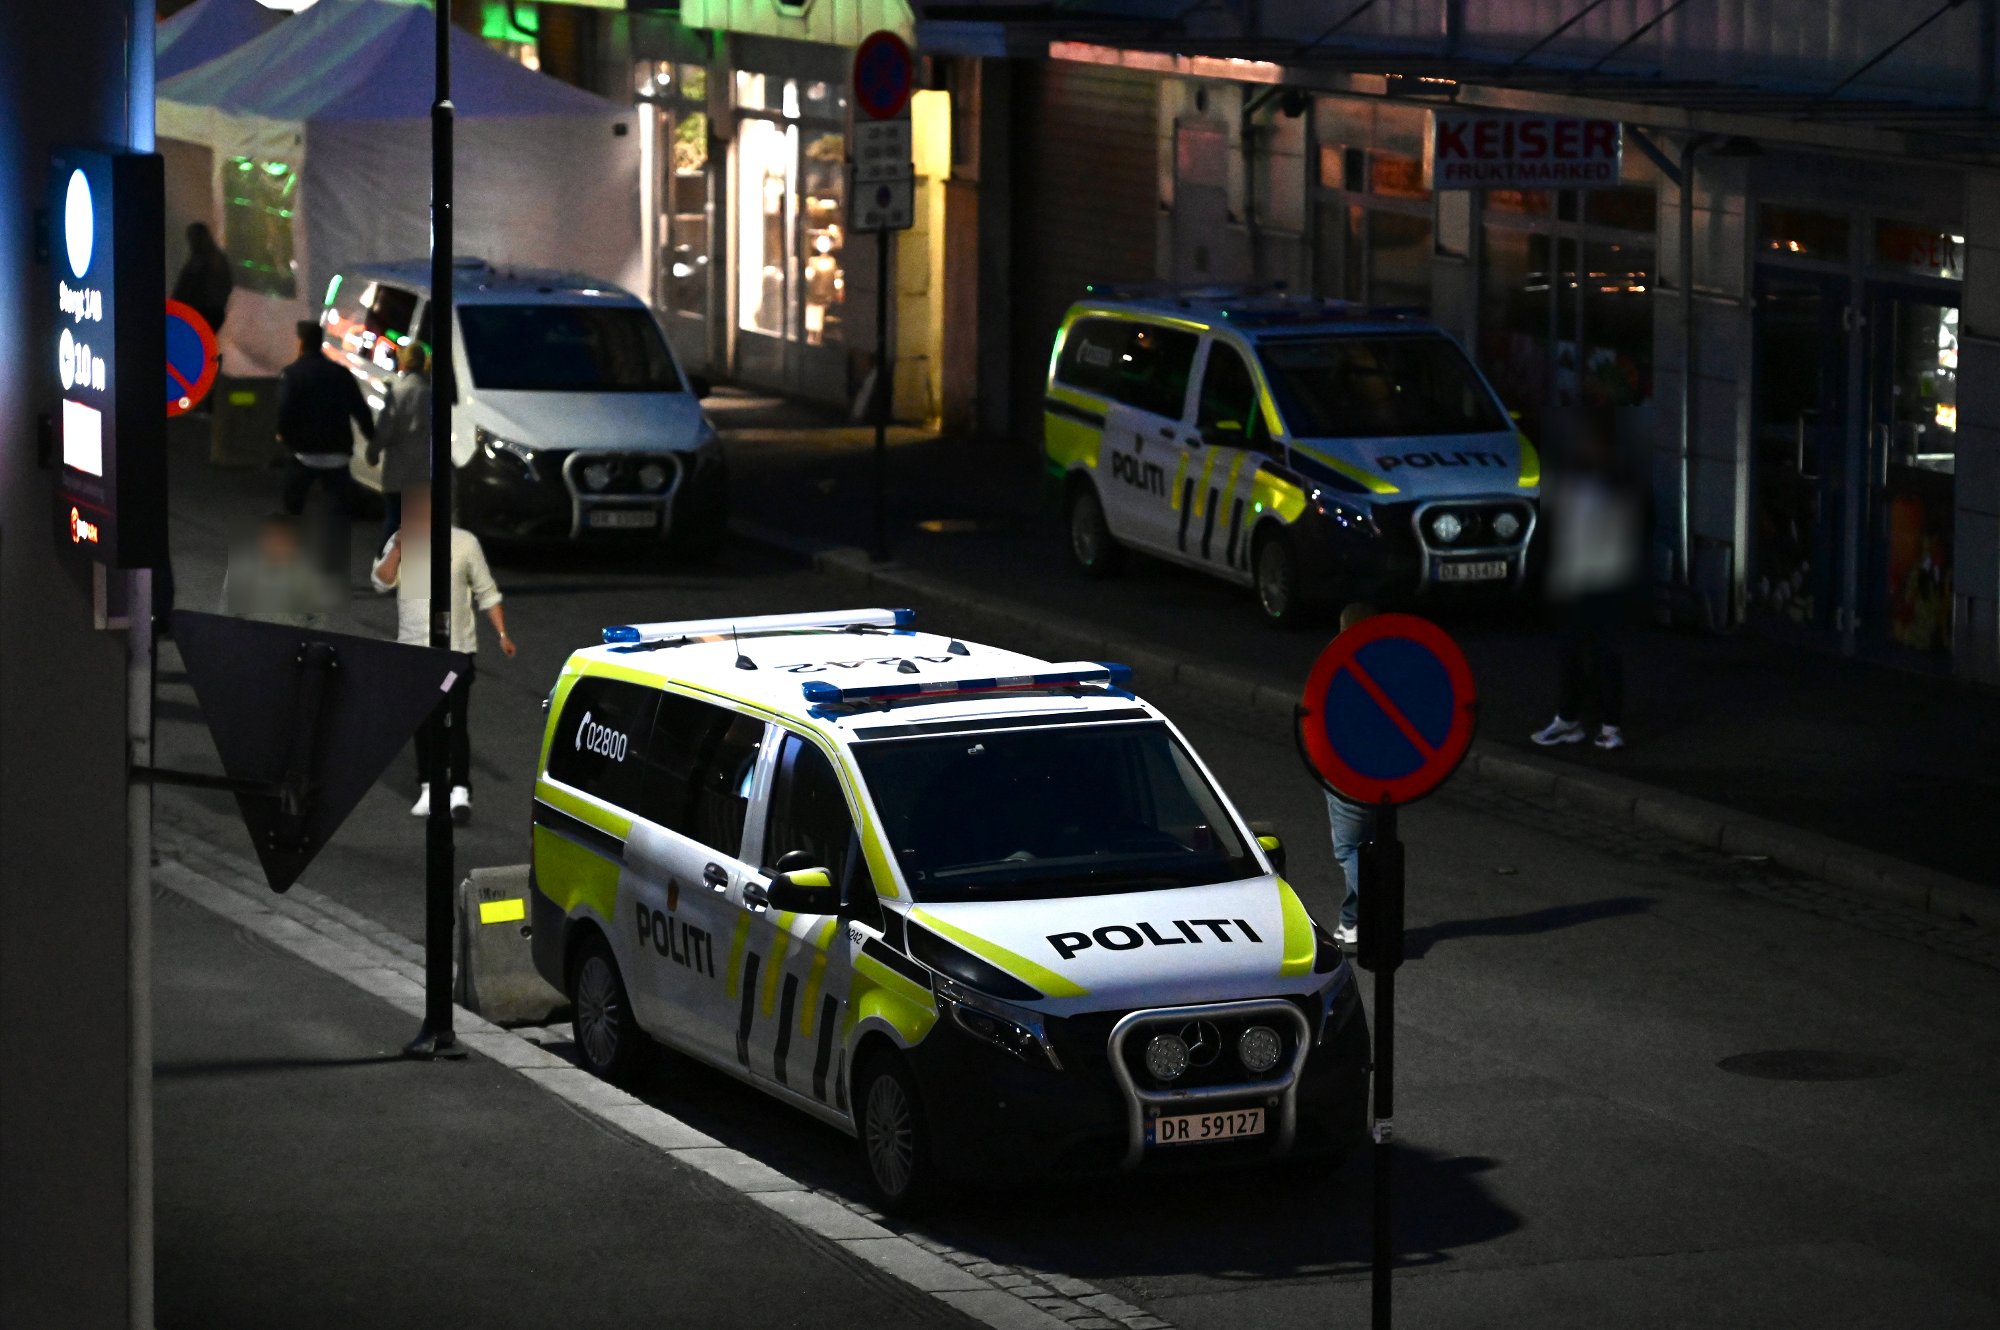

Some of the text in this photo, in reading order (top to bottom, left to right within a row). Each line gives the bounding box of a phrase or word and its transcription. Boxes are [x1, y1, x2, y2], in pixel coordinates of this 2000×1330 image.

[1438, 120, 1615, 159] KEISER
[1445, 162, 1611, 180] FRUKTMARKED
[1111, 451, 1165, 497] POLITI
[1375, 452, 1507, 471] POLITI
[586, 722, 628, 762] 02800
[636, 902, 715, 979] POLITI
[1045, 919, 1263, 960] POLITI
[1161, 1111, 1259, 1141] DR 59127
